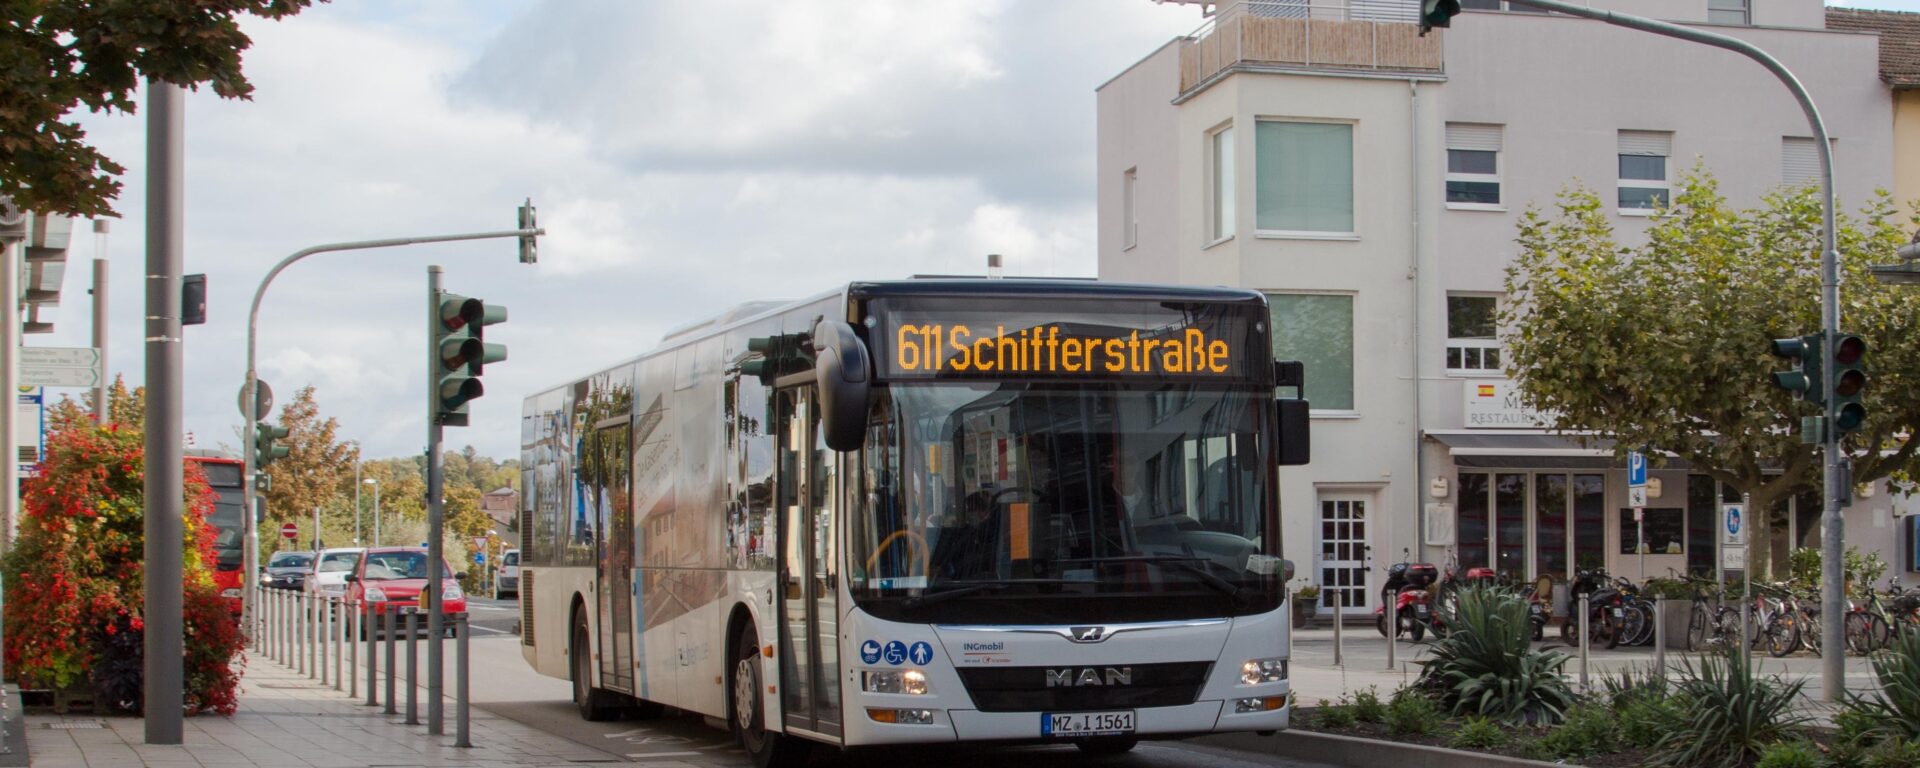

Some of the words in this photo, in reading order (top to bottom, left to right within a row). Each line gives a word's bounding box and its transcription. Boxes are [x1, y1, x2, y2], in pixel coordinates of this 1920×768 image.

[898, 324, 942, 370] 611
[950, 325, 1228, 372] Schifferstraße
[1632, 451, 1642, 481] P
[963, 642, 1004, 651] INGmobil
[1046, 667, 1132, 687] MAN
[1052, 715, 1072, 731] MZ
[1083, 715, 1091, 730] I
[1096, 714, 1132, 730] 1561
